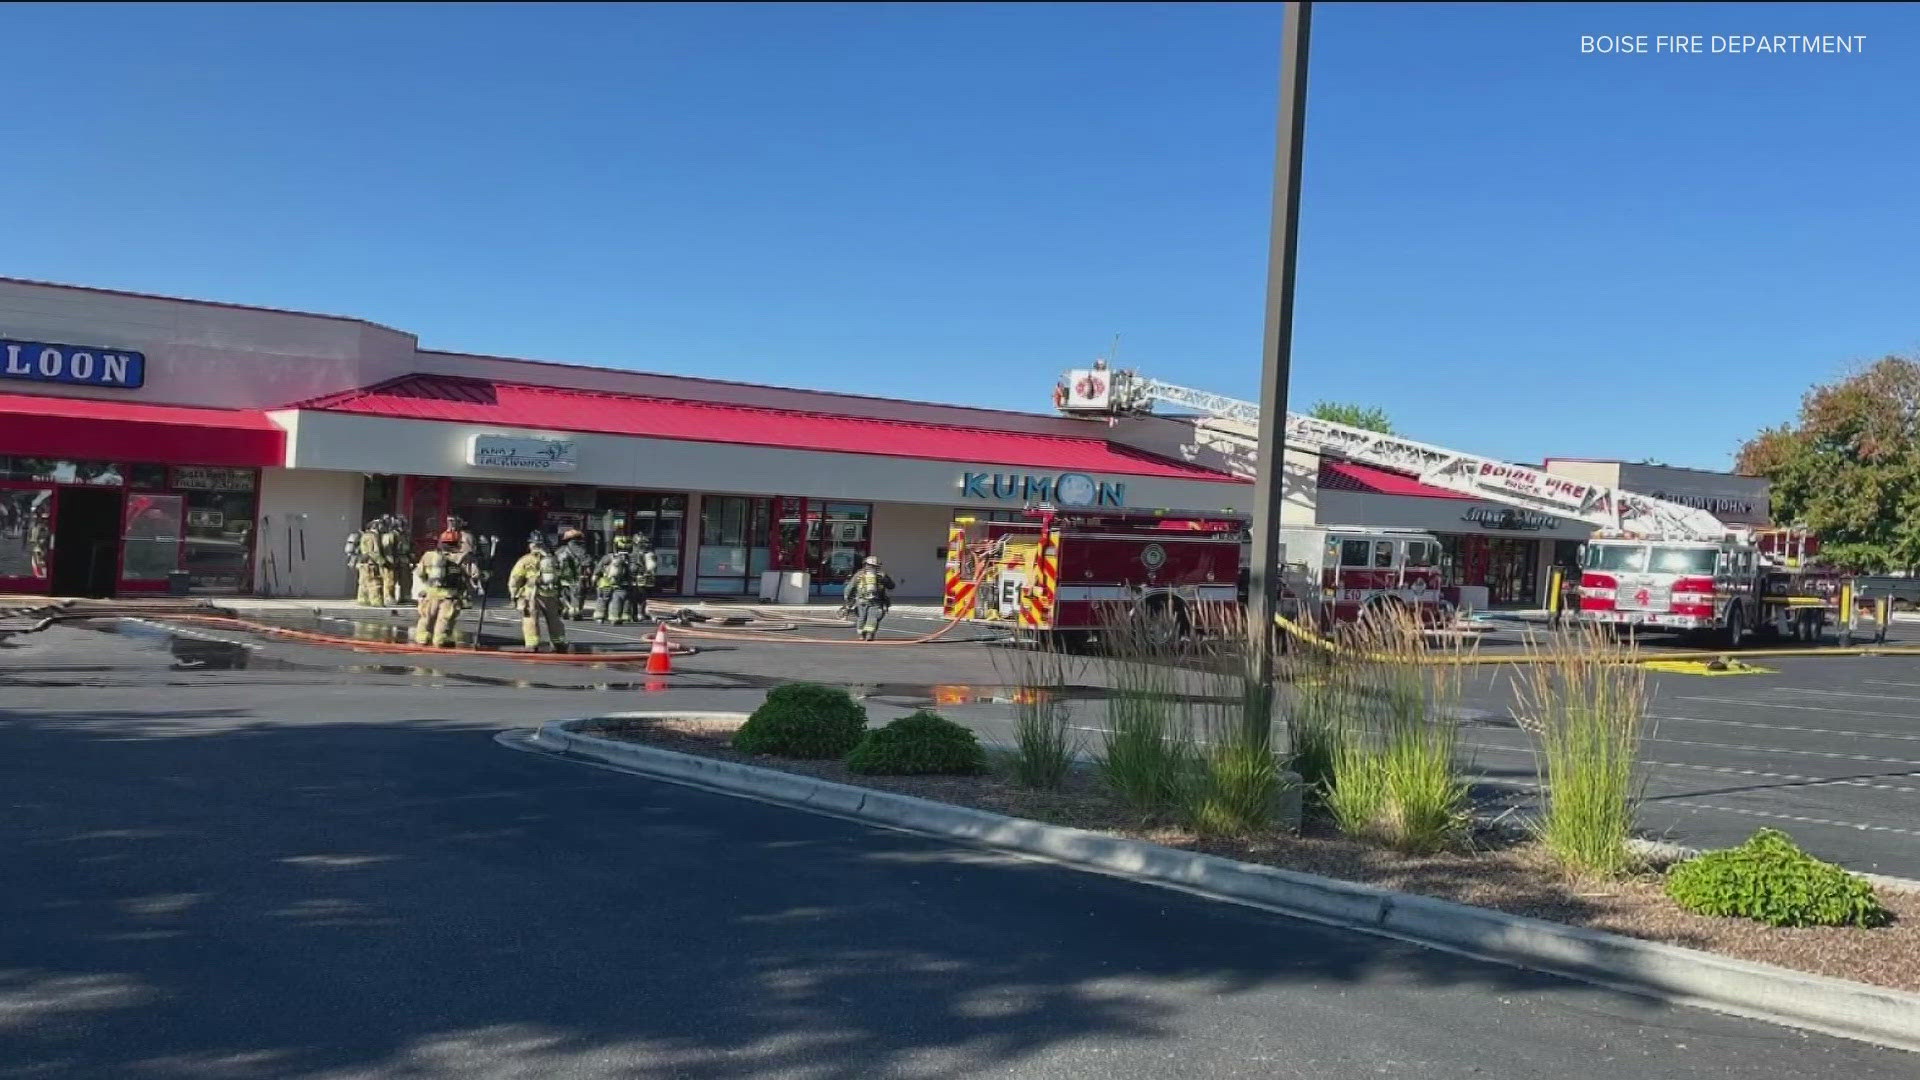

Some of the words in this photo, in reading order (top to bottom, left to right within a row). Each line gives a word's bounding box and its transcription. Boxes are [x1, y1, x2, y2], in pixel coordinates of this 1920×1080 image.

[5, 345, 130, 383] LOON
[962, 471, 1125, 507] KUMON
[1634, 588, 1651, 607] 4
